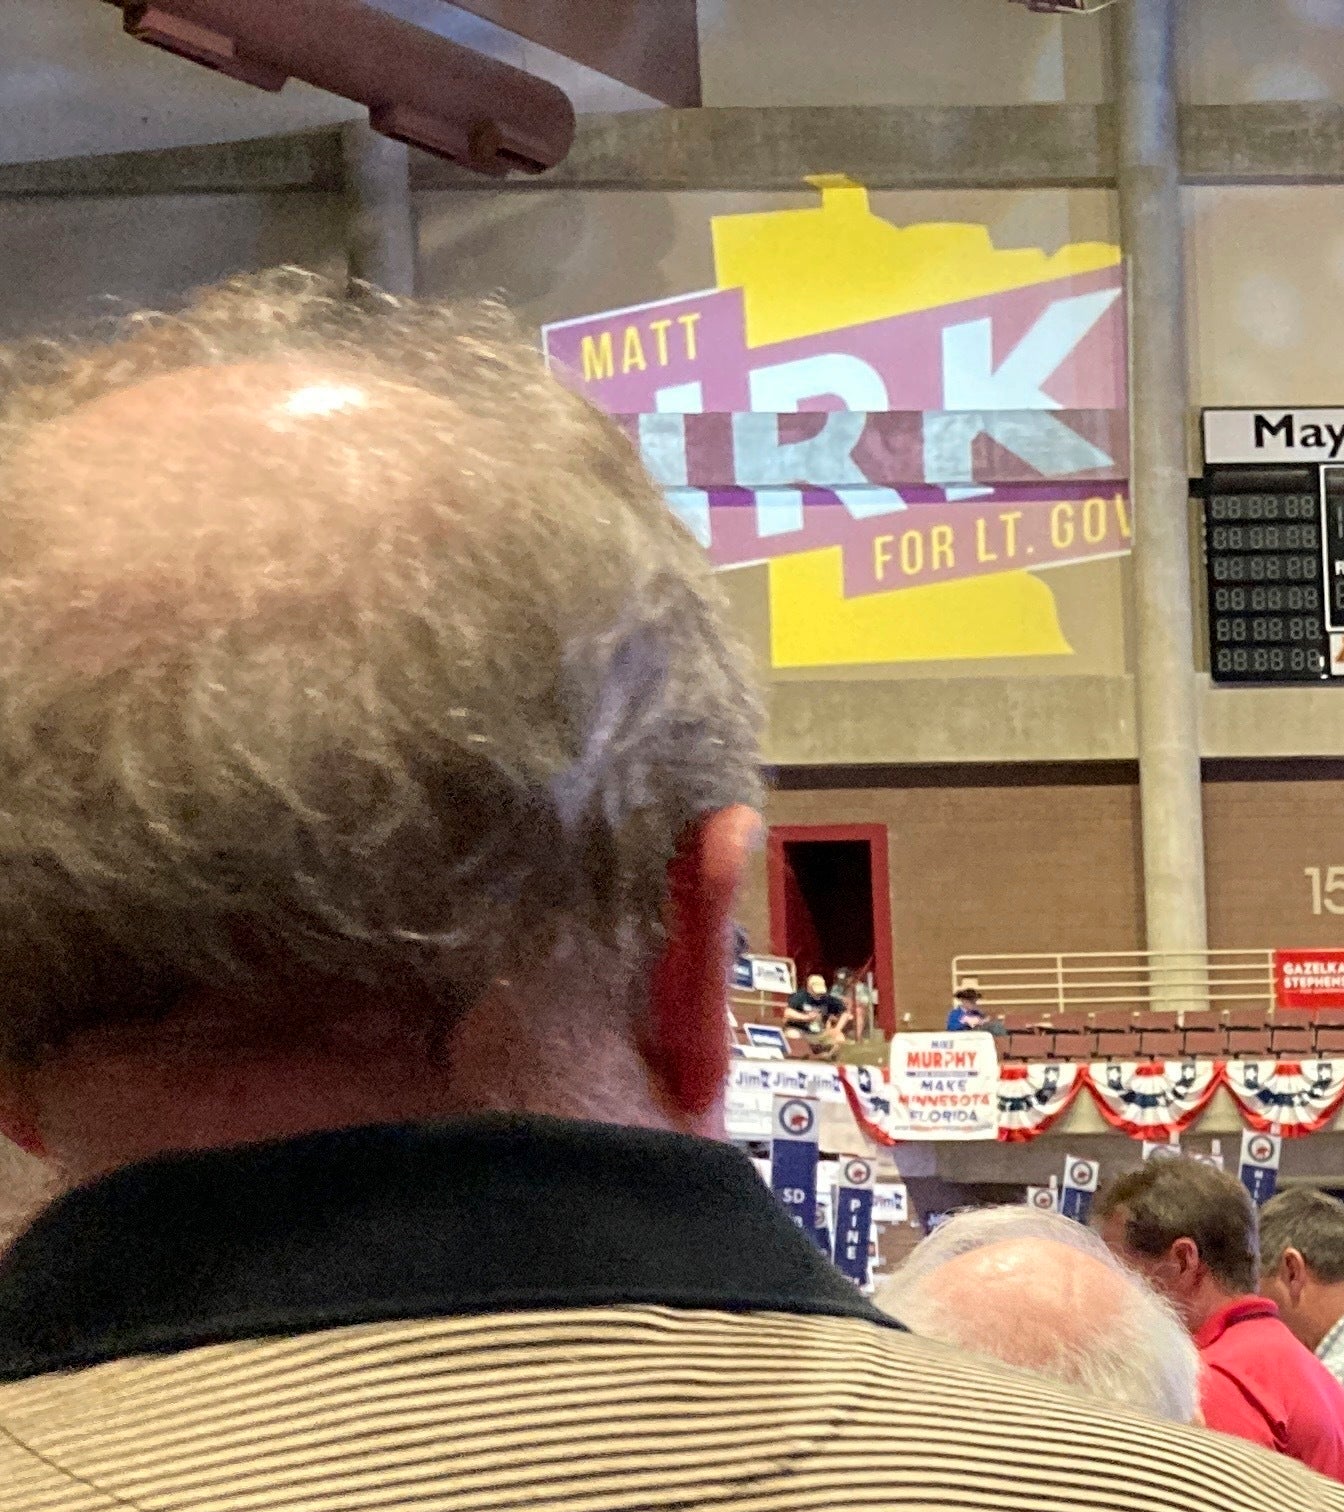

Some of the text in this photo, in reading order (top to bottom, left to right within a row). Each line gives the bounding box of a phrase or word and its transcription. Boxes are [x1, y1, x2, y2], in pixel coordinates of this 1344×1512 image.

[580, 313, 701, 382] MATT
[637, 287, 1122, 548] IRK
[874, 524, 956, 581] FOR
[976, 512, 1033, 565] LT.
[907, 1052, 978, 1069] MURPHY
[899, 1094, 991, 1107] MINNESOTA
[921, 1080, 968, 1092] MAKE
[783, 1188, 805, 1204] SD
[847, 1198, 862, 1261] PINE
